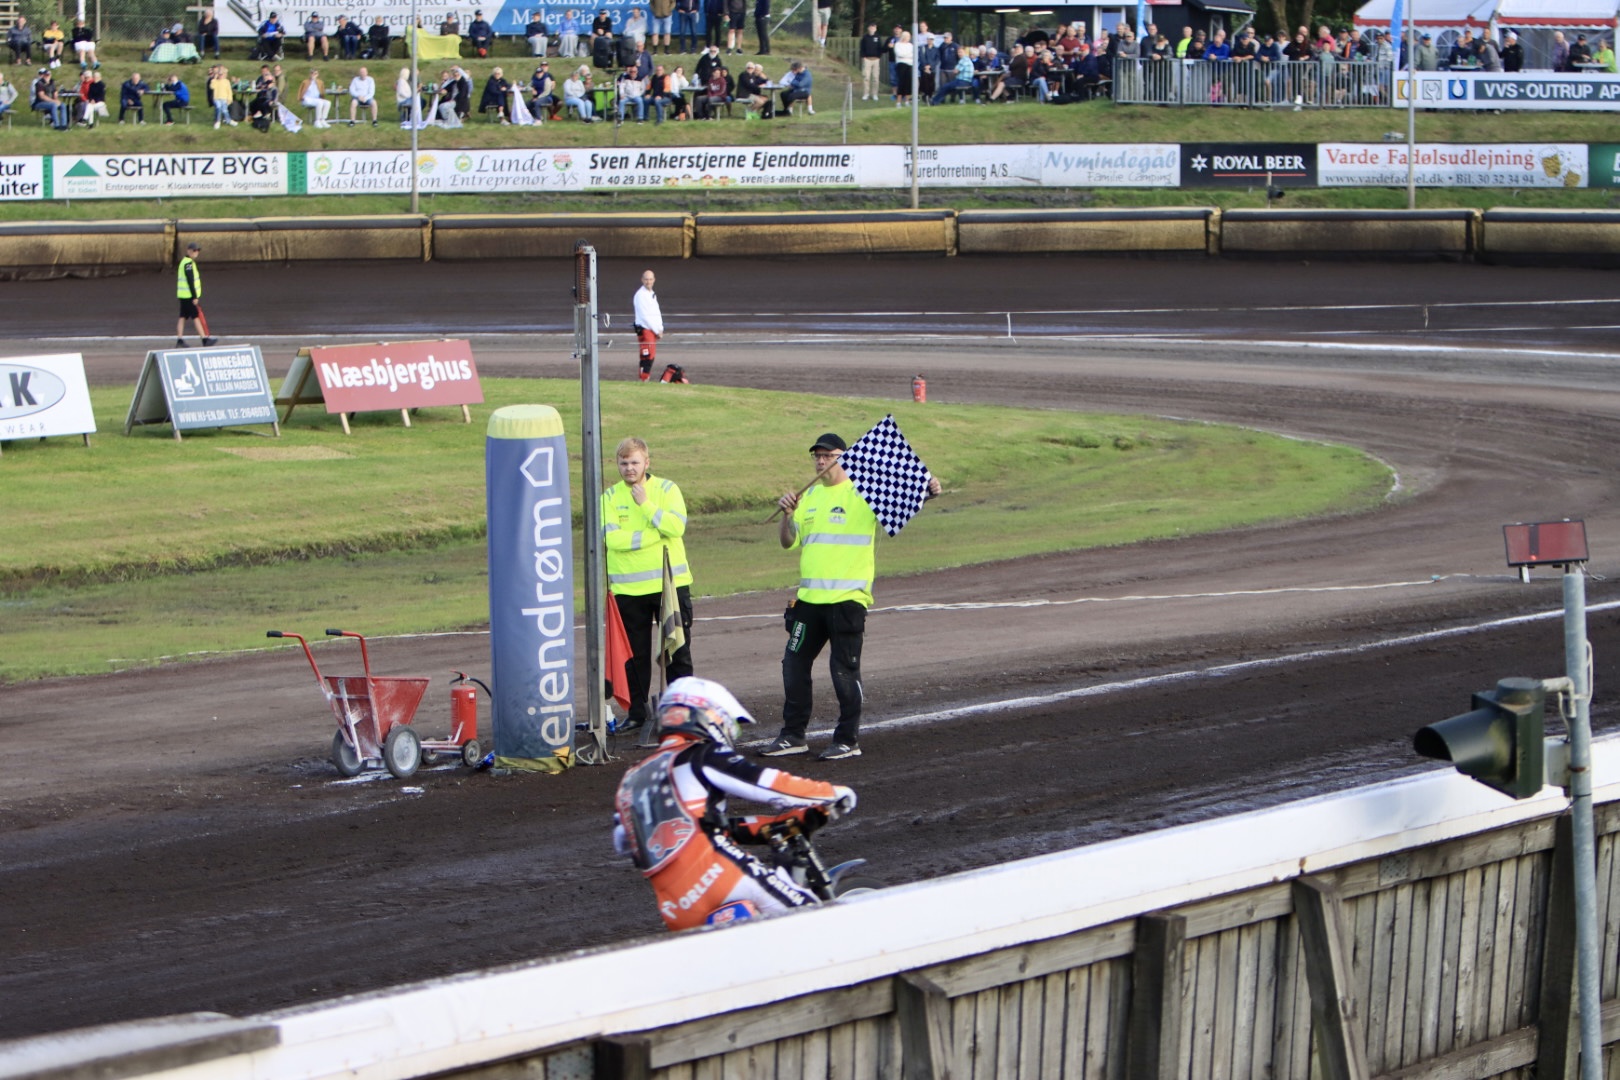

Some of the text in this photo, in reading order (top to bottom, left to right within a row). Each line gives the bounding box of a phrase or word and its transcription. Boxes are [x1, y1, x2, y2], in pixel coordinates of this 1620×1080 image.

[337, 153, 410, 175] Lunde
[476, 152, 548, 172] Lunde
[589, 153, 629, 169] Sven
[635, 152, 747, 172] Ankerstjerne
[752, 151, 851, 171] Ejendomme
[905, 147, 938, 160] Hnne
[1043, 150, 1177, 173] Nymindegab
[1212, 155, 1306, 170] ROYAL BEER
[1325, 148, 1535, 170] Varde Fadølsudlejning
[105, 156, 268, 177] SCHANTZ BYG
[990, 163, 1009, 178] A/S
[167, 181, 223, 190] Kloakmester
[232, 180, 279, 190] Vognmand
[311, 173, 441, 190] Maskinstaton
[607, 175, 620, 185] 40
[623, 175, 635, 185] 29
[638, 175, 647, 185] 13
[649, 175, 662, 185] 52
[1325, 173, 1444, 185] www.vardefadel.dk
[1478, 174, 1490, 184] 30
[1493, 174, 1505, 184] 32
[1508, 174, 1520, 184] 34
[1522, 174, 1535, 184] 94
[320, 355, 473, 392] Næsbjerghus
[0, 371, 38, 407] K
[521, 497, 573, 746] ejendrøm
[678, 862, 724, 910] ORLEN
